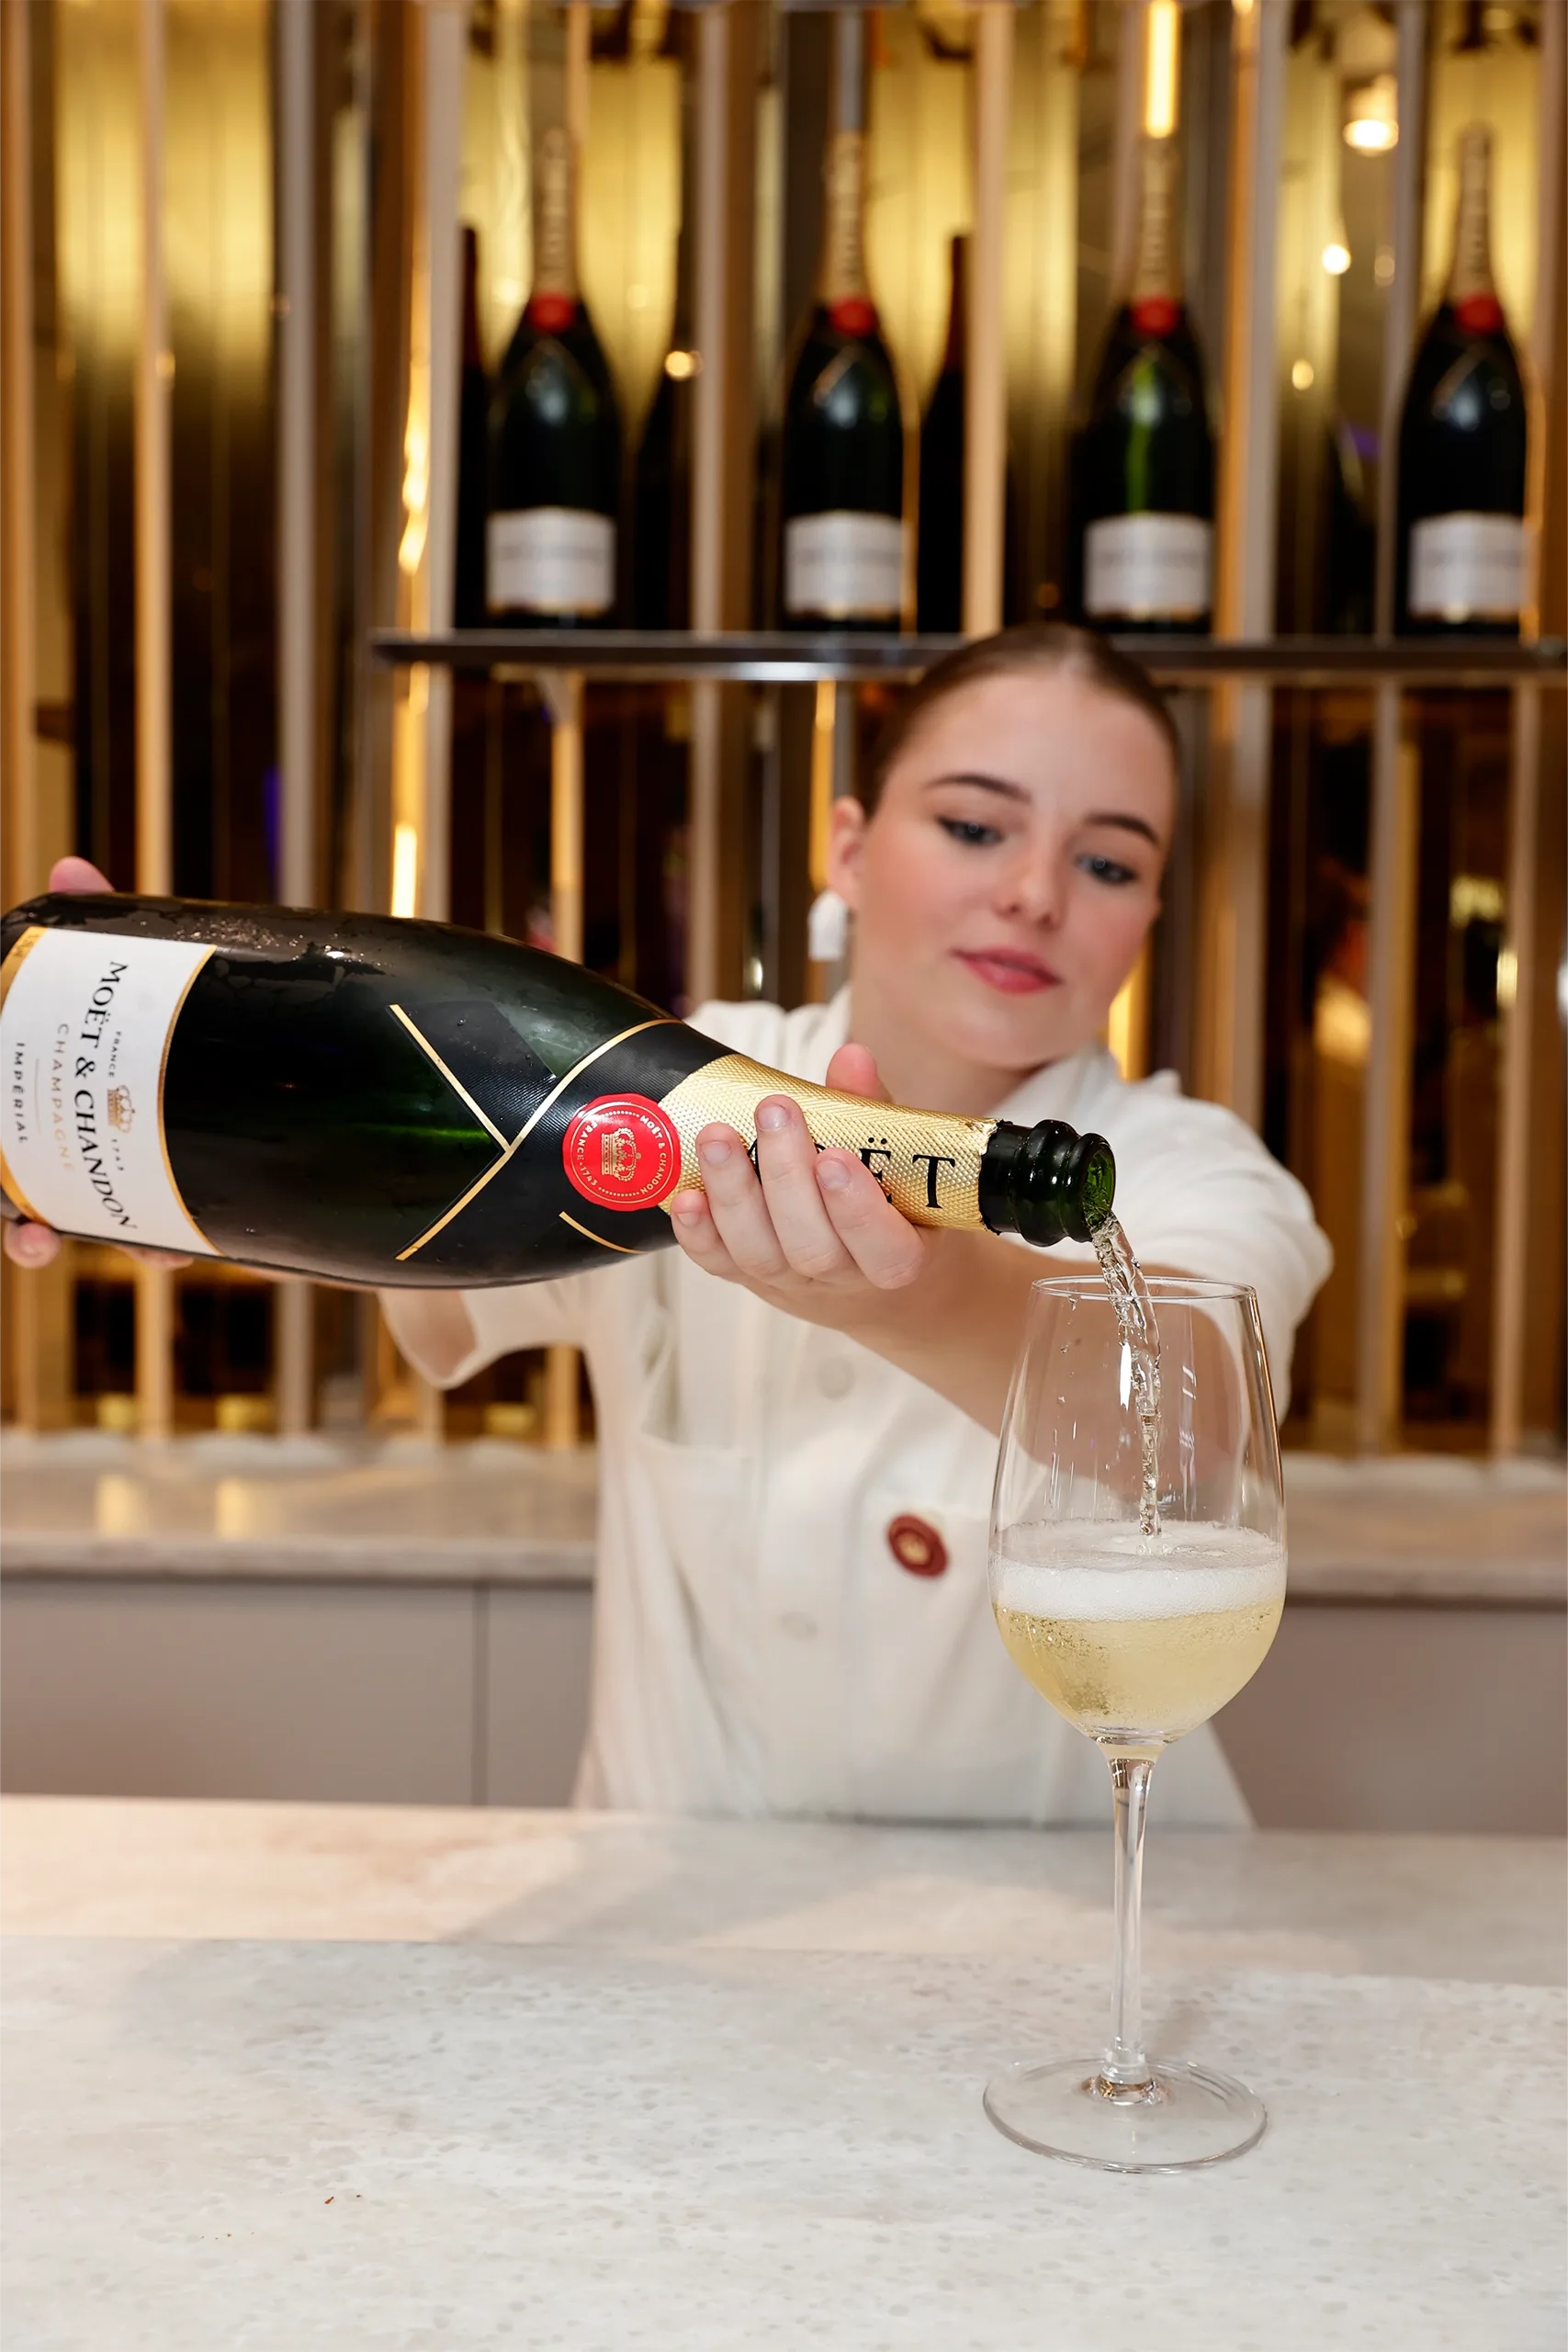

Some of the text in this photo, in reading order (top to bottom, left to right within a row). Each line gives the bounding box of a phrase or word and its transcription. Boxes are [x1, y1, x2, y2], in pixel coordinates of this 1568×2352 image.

[108, 1031, 121, 1077] FRANCE
[51, 1023, 74, 1173] CHAMPAGNE
[73, 961, 138, 1229] MOËT & CHANDON
[577, 1120, 598, 1186] FRANCE 1743
[640, 1152, 667, 1194] CHANDON
